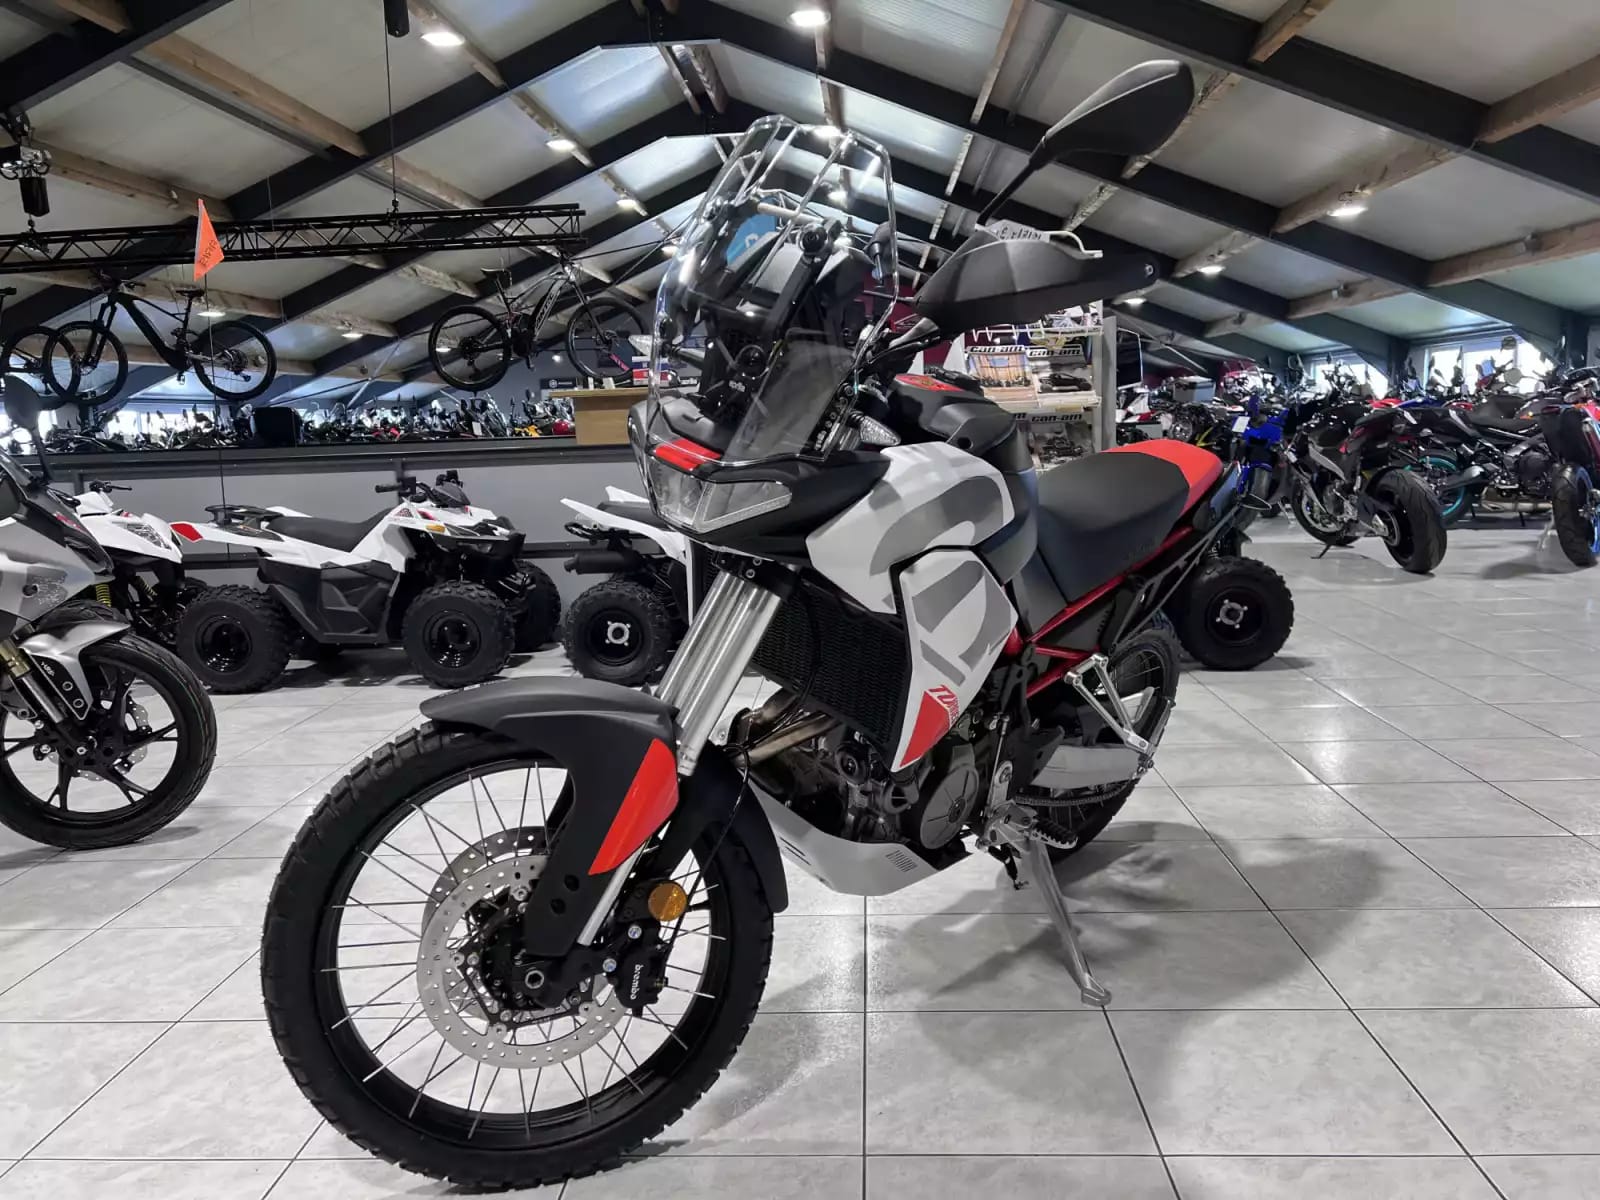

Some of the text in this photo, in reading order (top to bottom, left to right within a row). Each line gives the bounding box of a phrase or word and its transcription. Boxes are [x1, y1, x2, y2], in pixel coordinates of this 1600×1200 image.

[970, 345, 1024, 353] can-am
[1029, 348, 1081, 357] can-am
[1031, 413, 1082, 422] can-am
[630, 964, 644, 1000] brembo
